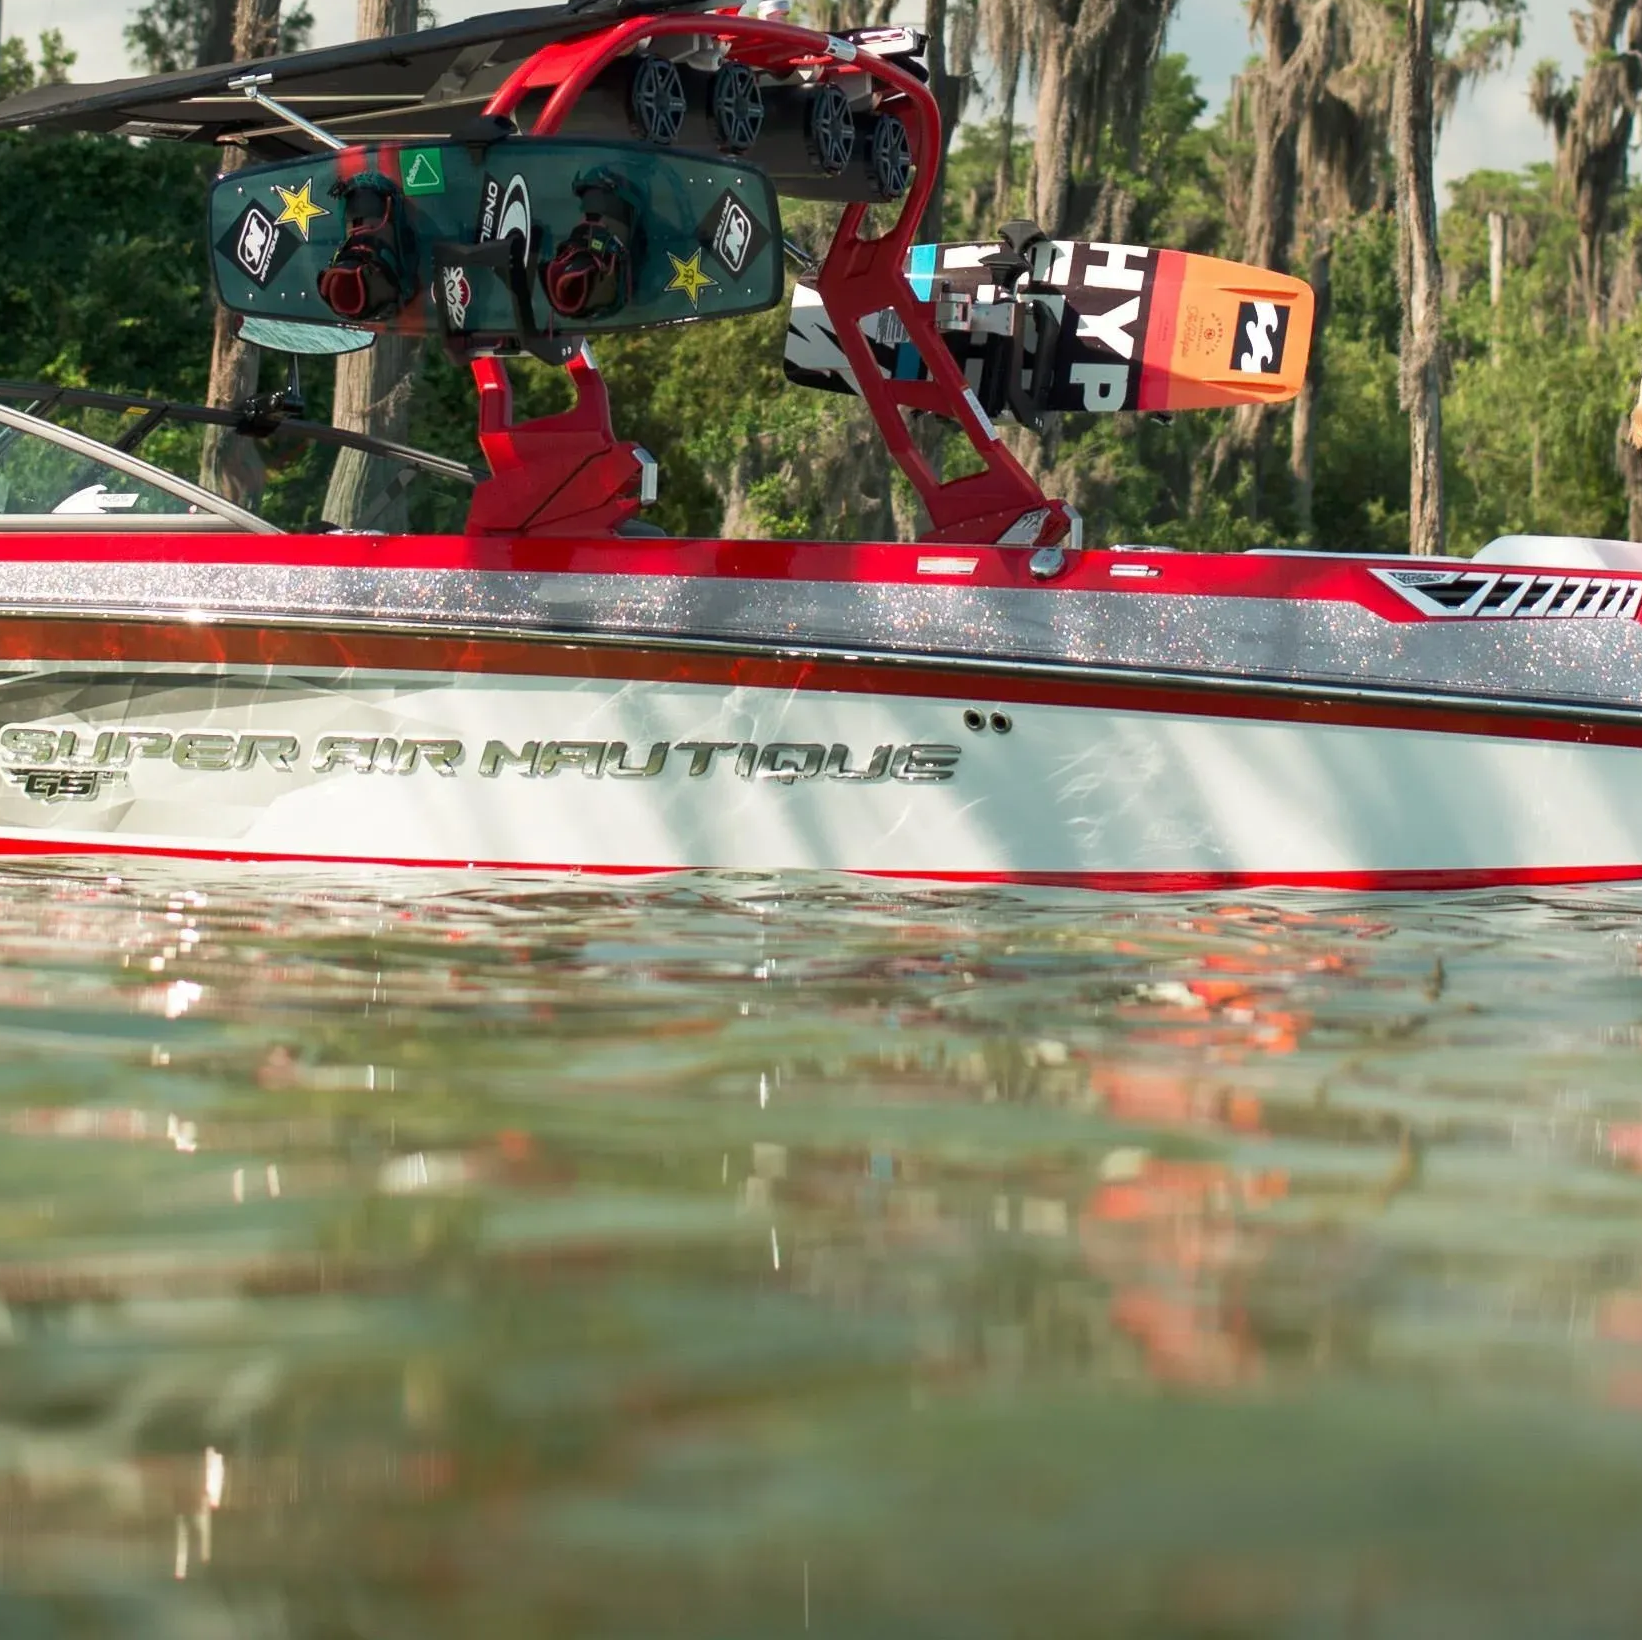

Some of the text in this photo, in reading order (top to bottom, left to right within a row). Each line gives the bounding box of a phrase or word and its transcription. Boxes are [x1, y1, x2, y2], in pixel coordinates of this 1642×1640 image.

[480, 181, 498, 244] O'NEIL
[260, 228, 280, 282] NAUTIQUE
[0, 726, 962, 786] SUPER AIR NAUTIQUE
[24, 770, 99, 800] GS
